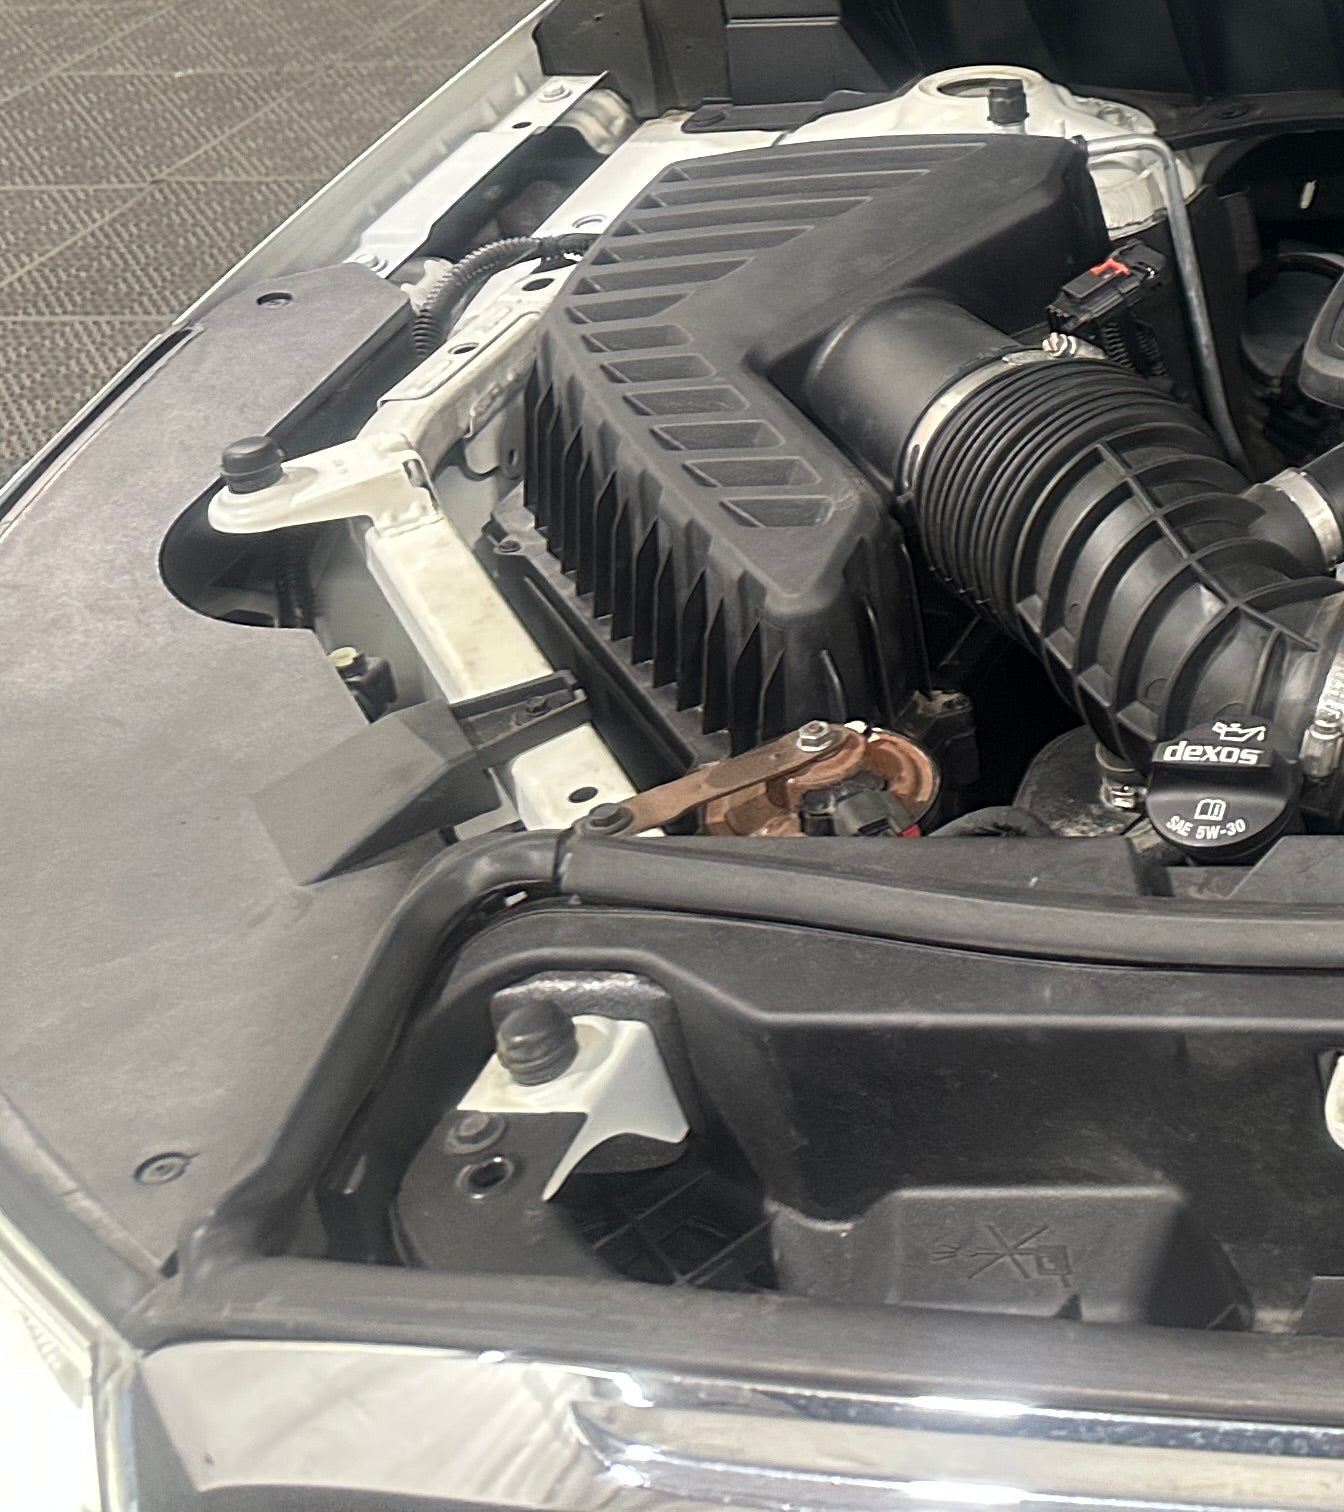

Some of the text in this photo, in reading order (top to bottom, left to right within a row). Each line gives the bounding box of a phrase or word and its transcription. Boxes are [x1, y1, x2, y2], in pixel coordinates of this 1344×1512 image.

[1163, 740, 1265, 765] dexos
[1166, 815, 1246, 840] SAE 5W-30
